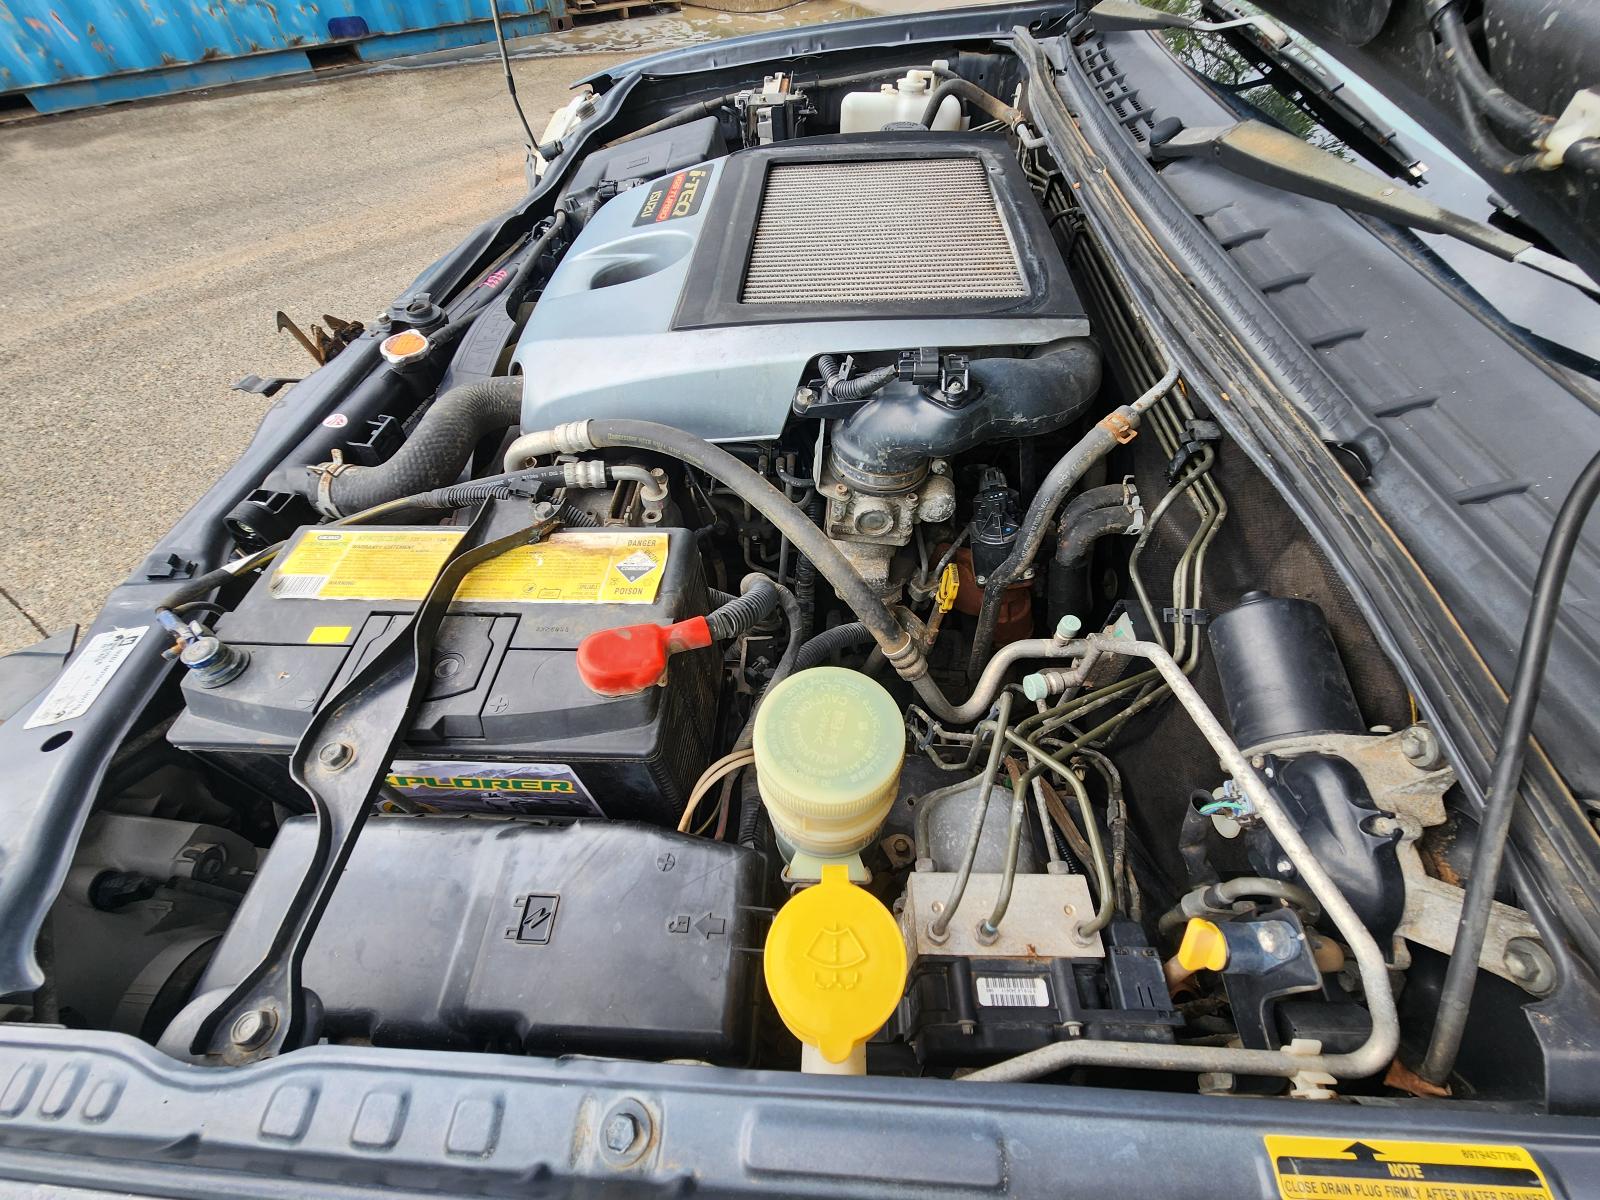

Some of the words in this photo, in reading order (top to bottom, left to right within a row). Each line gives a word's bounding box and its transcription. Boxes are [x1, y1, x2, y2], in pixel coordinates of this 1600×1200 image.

[640, 190, 663, 218] ISUZU
[627, 539, 657, 547] DANGER
[614, 587, 644, 595] POISON
[1387, 1163, 1425, 1179] NOTE
[1284, 1180, 1319, 1194] CLOSE
[1321, 1182, 1353, 1196] DRAIN
[1355, 1183, 1382, 1198] PLUG
[1384, 1185, 1421, 1199] FIRMLY
[1424, 1187, 1459, 1200] AFTER
[1459, 1189, 1498, 1200] WATER
